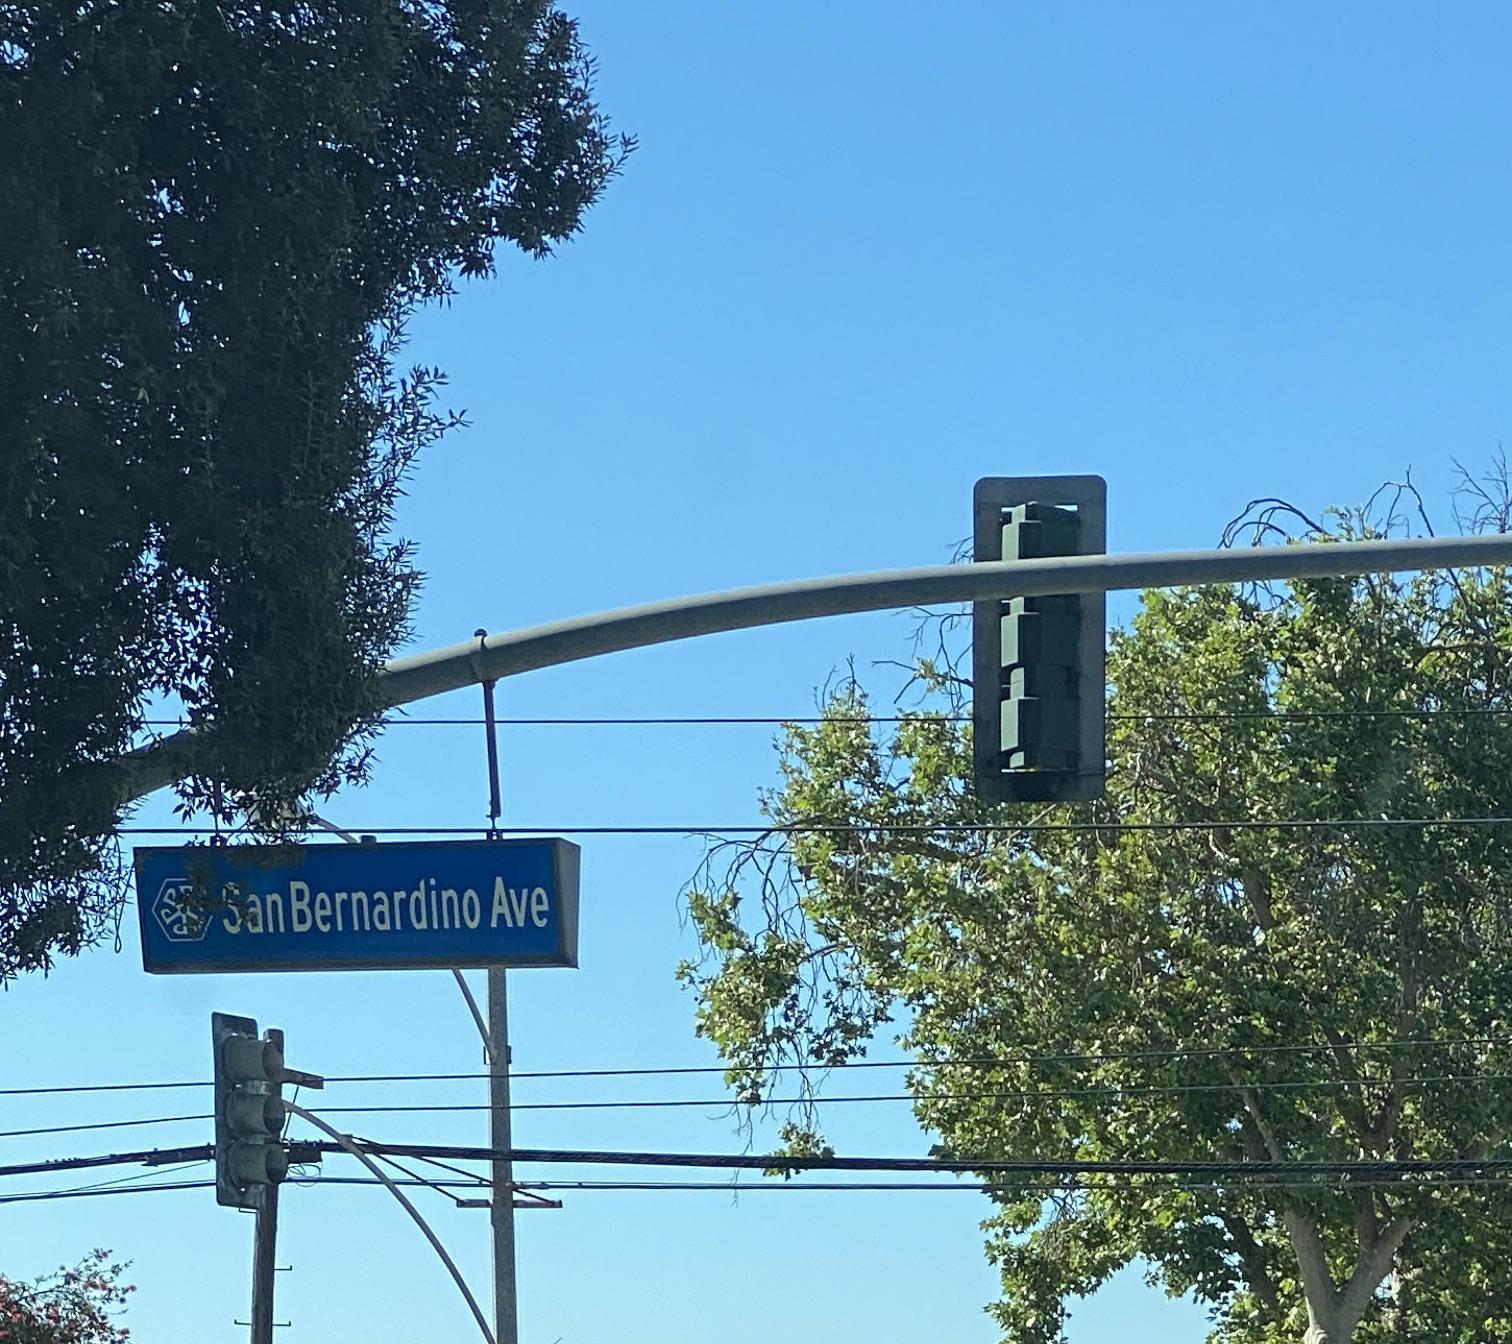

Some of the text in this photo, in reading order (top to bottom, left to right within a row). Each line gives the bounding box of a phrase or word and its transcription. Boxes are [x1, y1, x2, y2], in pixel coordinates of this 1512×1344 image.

[221, 876, 550, 935] San Bernardino Ave
